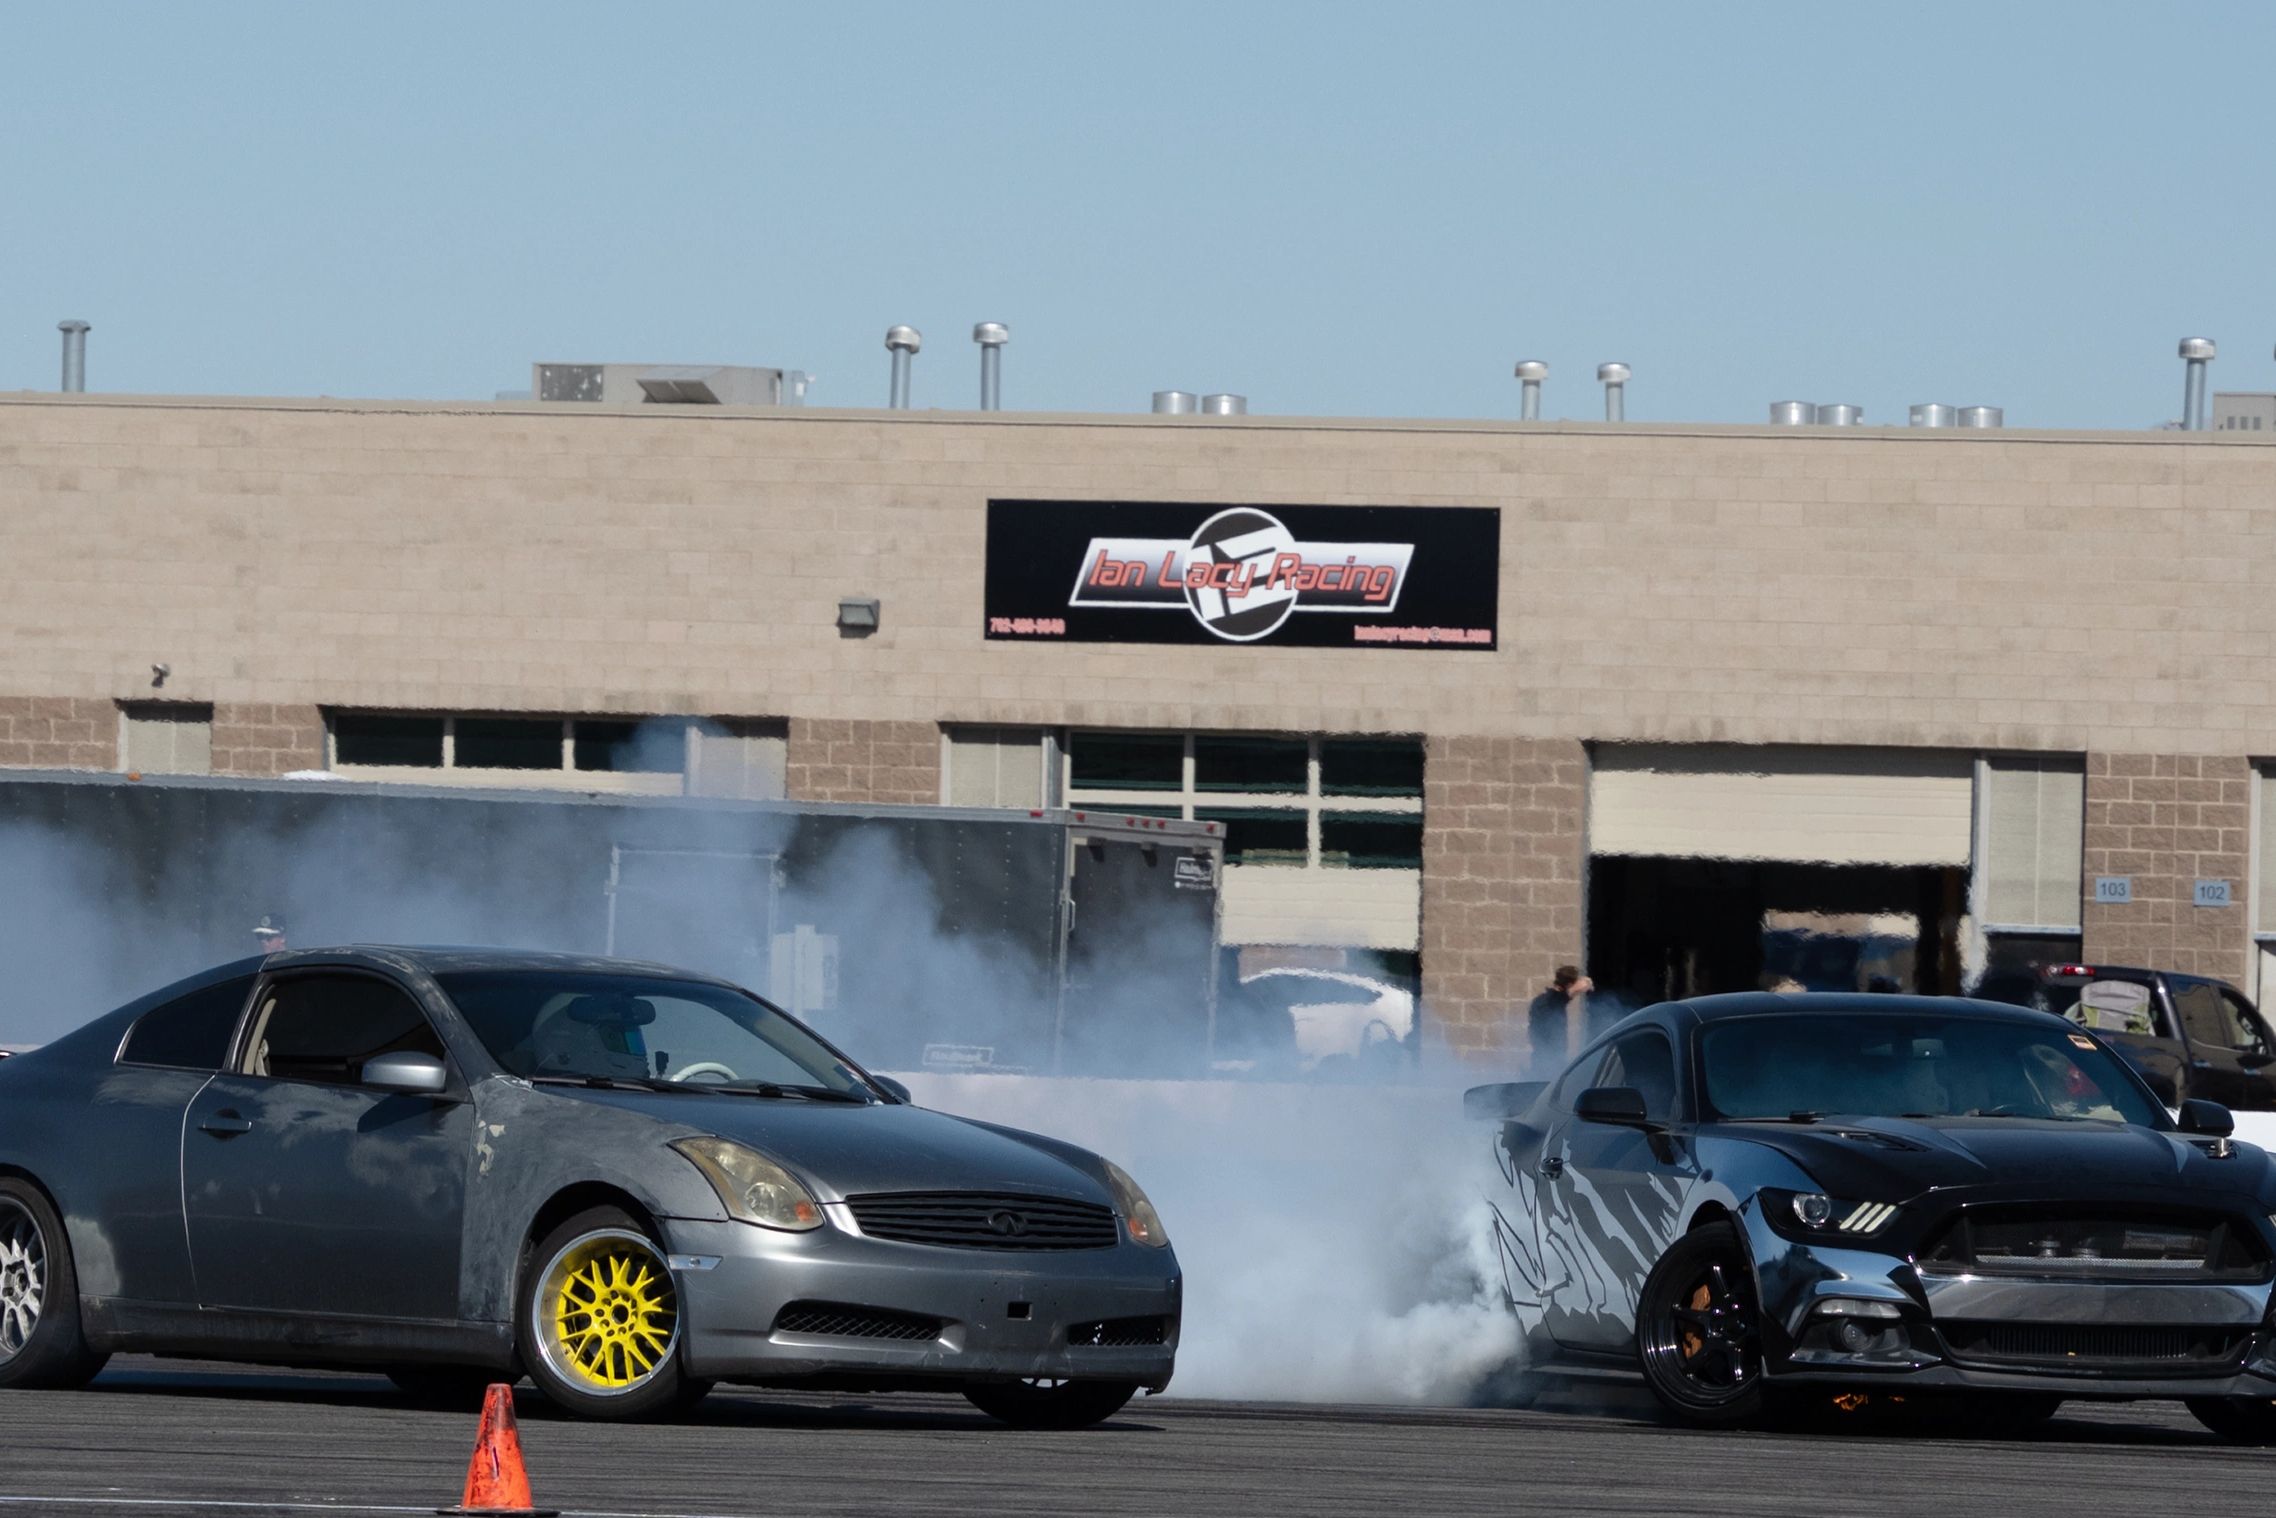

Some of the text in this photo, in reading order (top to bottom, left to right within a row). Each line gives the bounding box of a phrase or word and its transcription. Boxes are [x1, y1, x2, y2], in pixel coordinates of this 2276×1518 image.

[1089, 548, 1396, 601] Ian Lacy Racing
[2100, 882, 2127, 897] 103
[2199, 885, 2225, 900] 102
